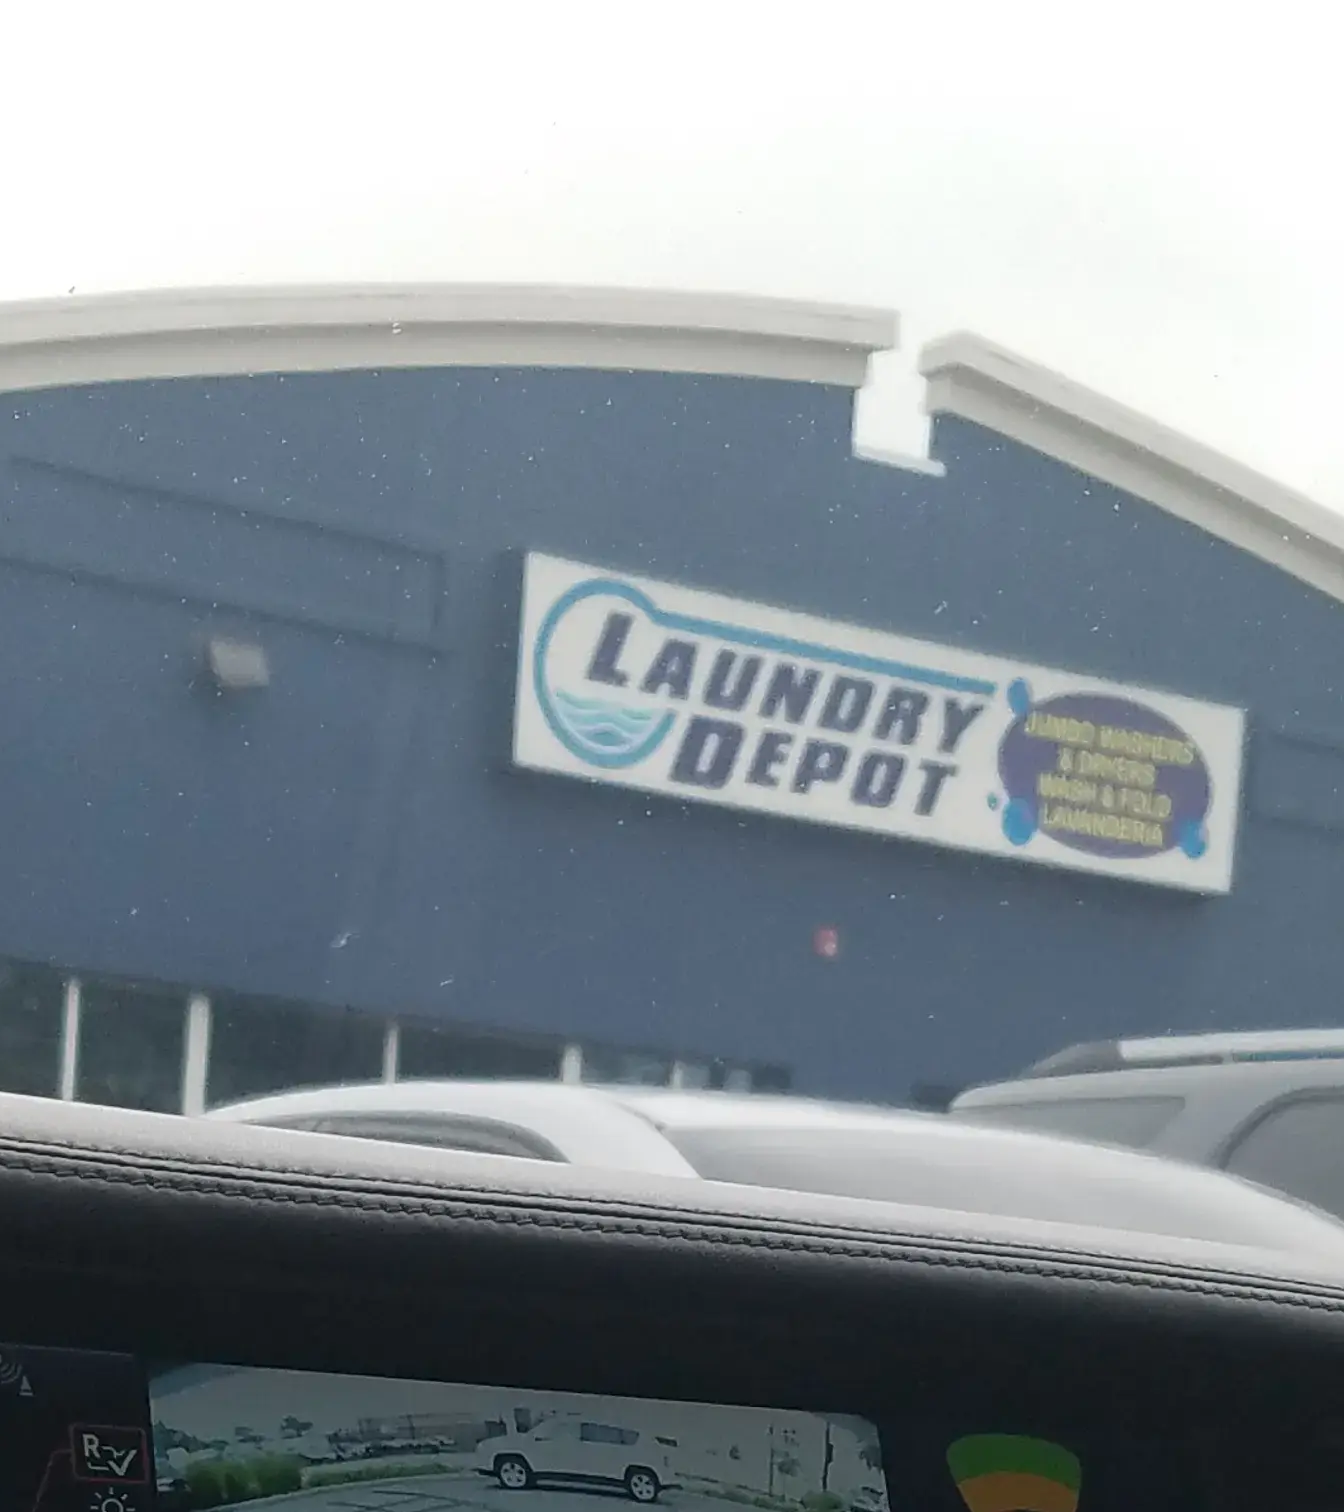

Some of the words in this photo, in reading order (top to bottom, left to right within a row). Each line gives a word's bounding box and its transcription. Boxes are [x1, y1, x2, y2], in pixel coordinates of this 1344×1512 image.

[586, 611, 984, 753] LAUNDRY
[669, 714, 958, 816] DEPOT
[82, 1433, 101, 1458] R
